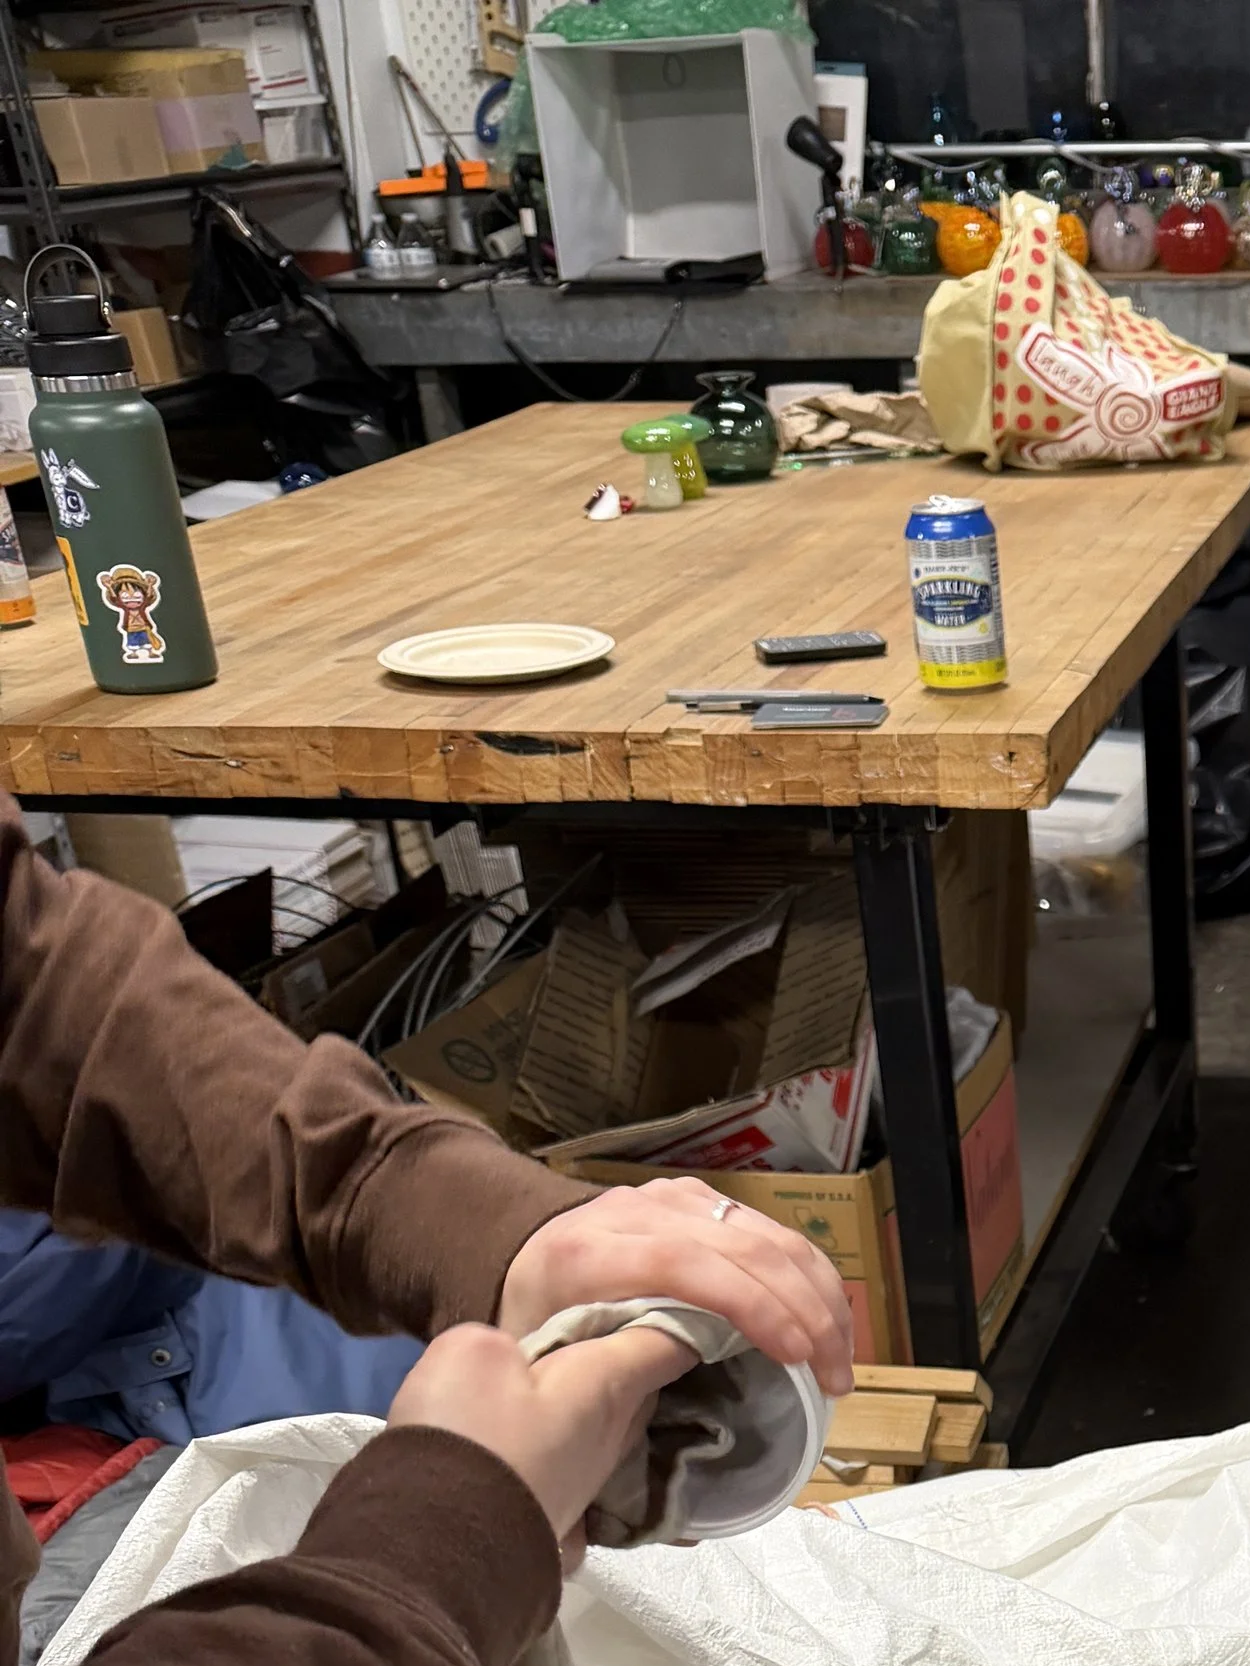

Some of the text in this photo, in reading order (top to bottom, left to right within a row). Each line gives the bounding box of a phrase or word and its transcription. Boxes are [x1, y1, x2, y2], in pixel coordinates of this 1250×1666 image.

[1166, 384, 1219, 405] GIANT
[1166, 397, 1217, 420] EAGLE
[66, 494, 78, 511] C
[917, 580, 981, 600] SPARKLING
[934, 615, 966, 626] WATER
